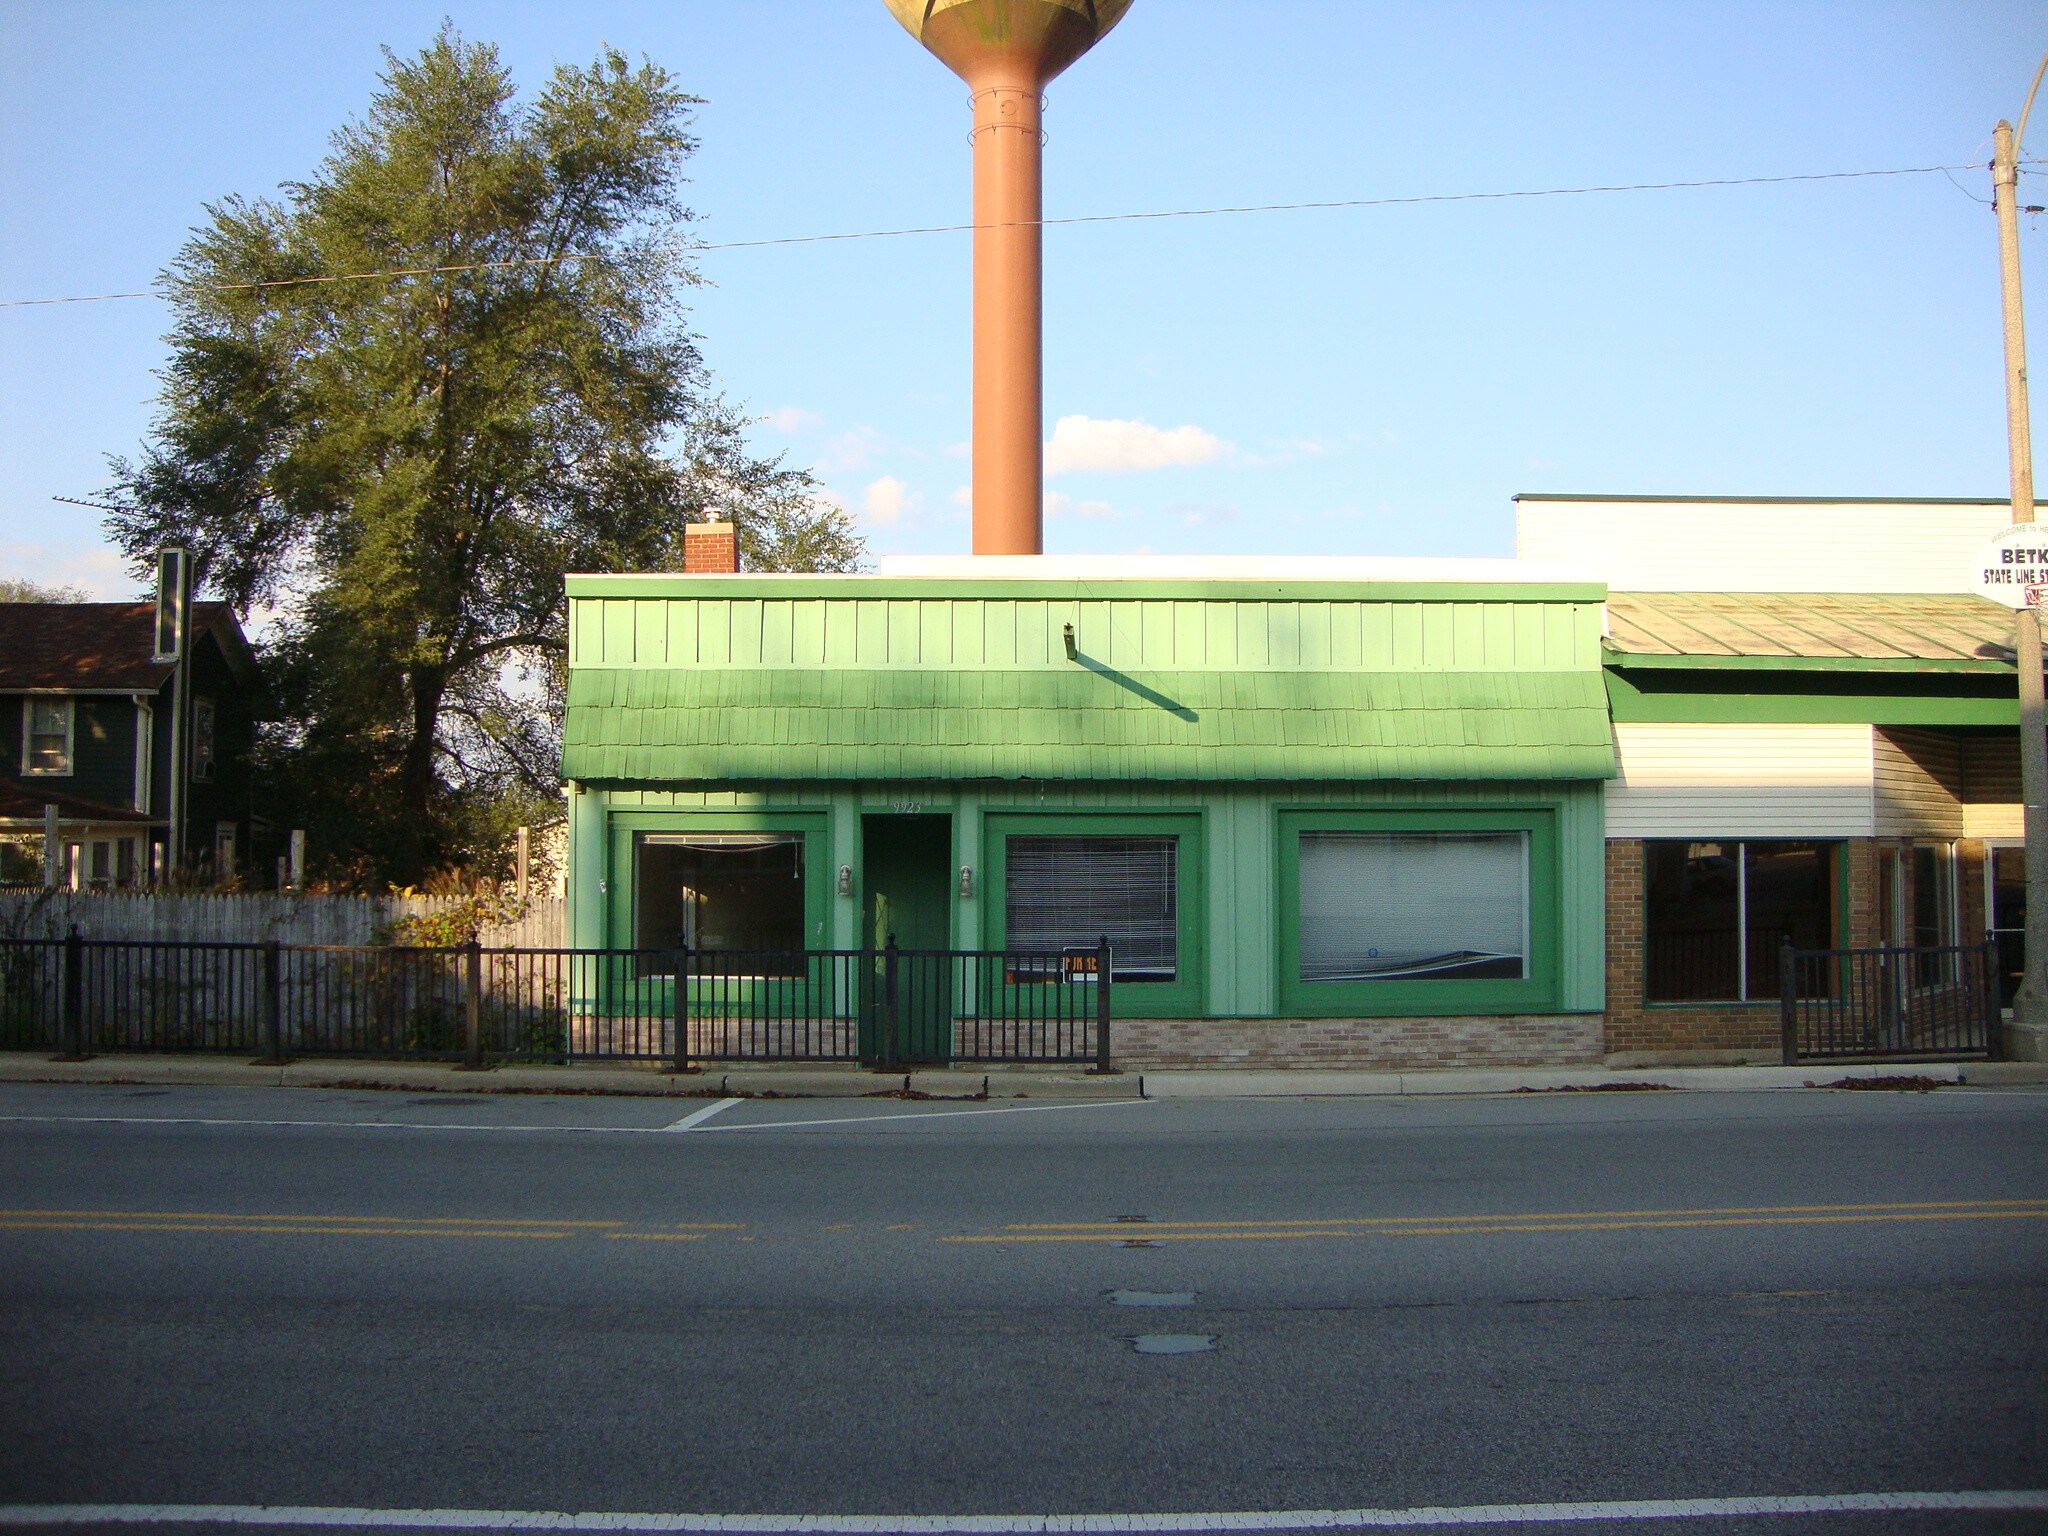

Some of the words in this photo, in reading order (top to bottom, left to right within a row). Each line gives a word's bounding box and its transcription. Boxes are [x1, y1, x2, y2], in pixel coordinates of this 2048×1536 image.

[1991, 525, 2027, 543] WELCOME
[1984, 569, 2012, 584] STATE
[2016, 569, 2035, 584] LINE
[893, 801, 922, 813] 9923
